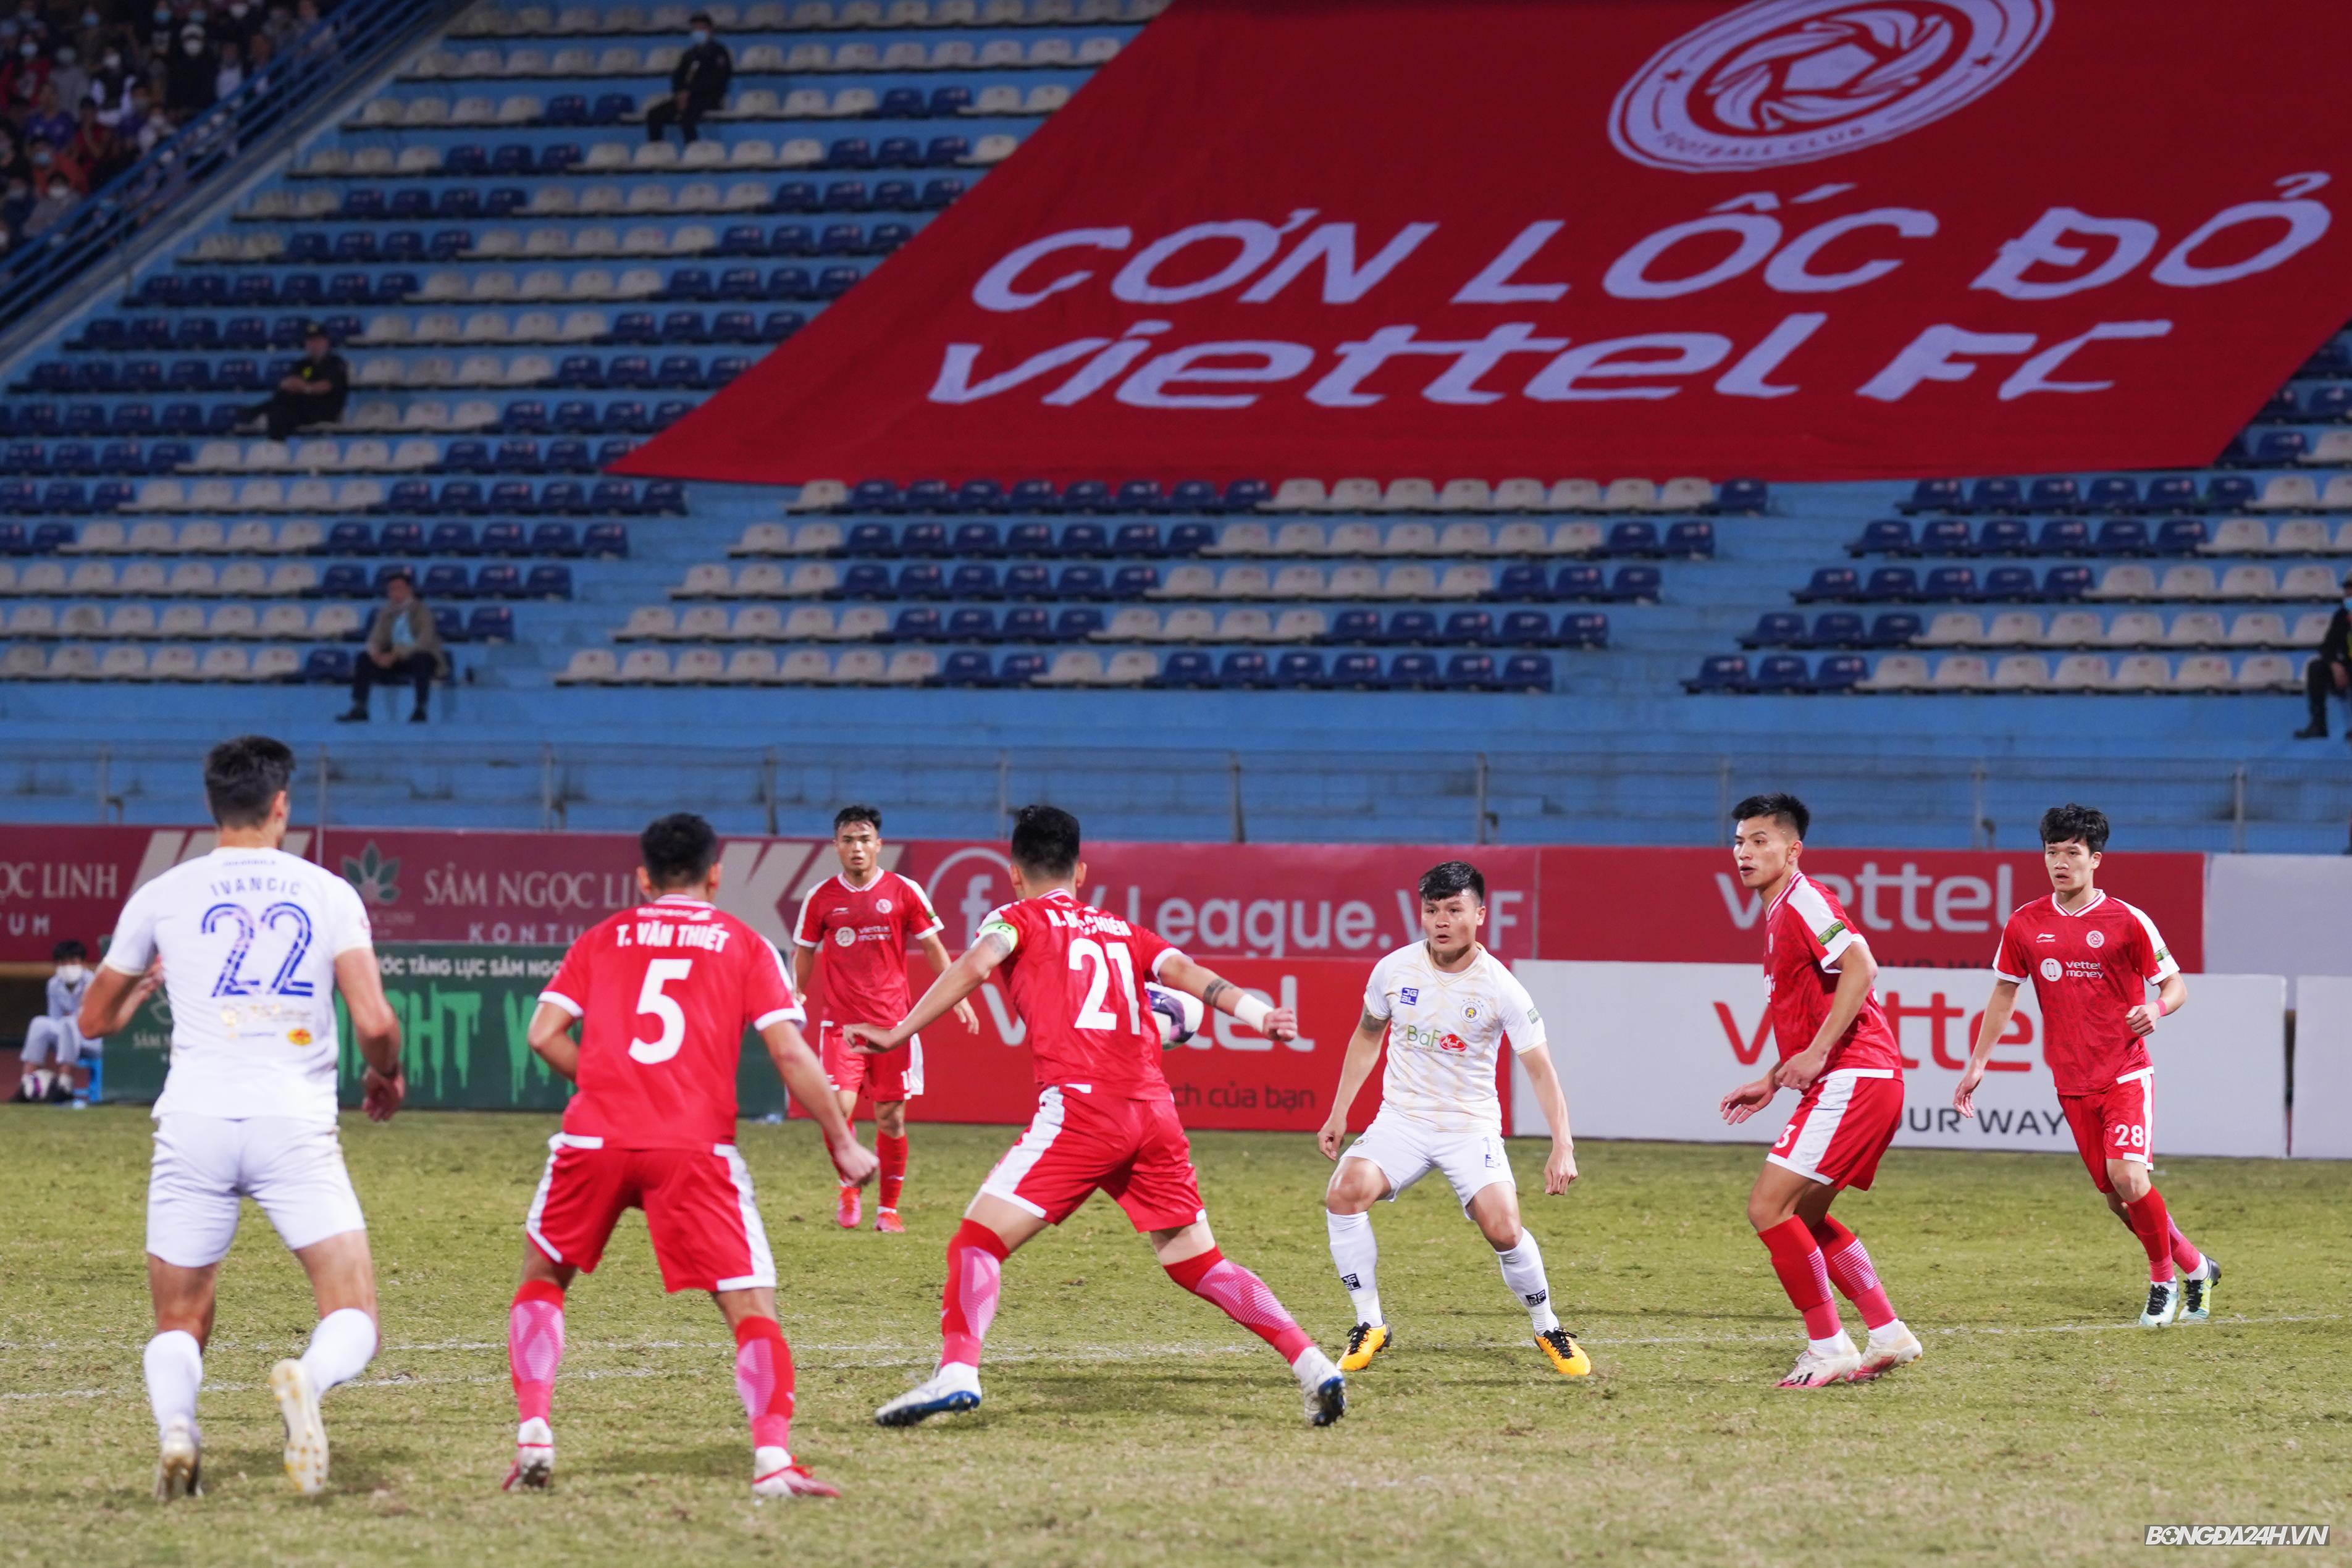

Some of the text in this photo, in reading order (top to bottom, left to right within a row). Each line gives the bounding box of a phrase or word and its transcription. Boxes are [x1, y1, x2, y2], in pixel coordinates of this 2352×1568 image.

[971, 170, 2332, 312] CƠN LỐC ĐỎ
[1854, 319, 2174, 402] FC
[41, 863, 119, 900] LINH
[497, 870, 595, 914] NGỌC
[200, 902, 314, 998] 22
[636, 920, 674, 947] VĂN
[676, 923, 731, 954] THIẾT
[628, 958, 693, 1066] 5
[1068, 937, 1141, 1036] 21
[1264, 1084, 1315, 1114] bạn
[2114, 1123, 2145, 1148] 28
